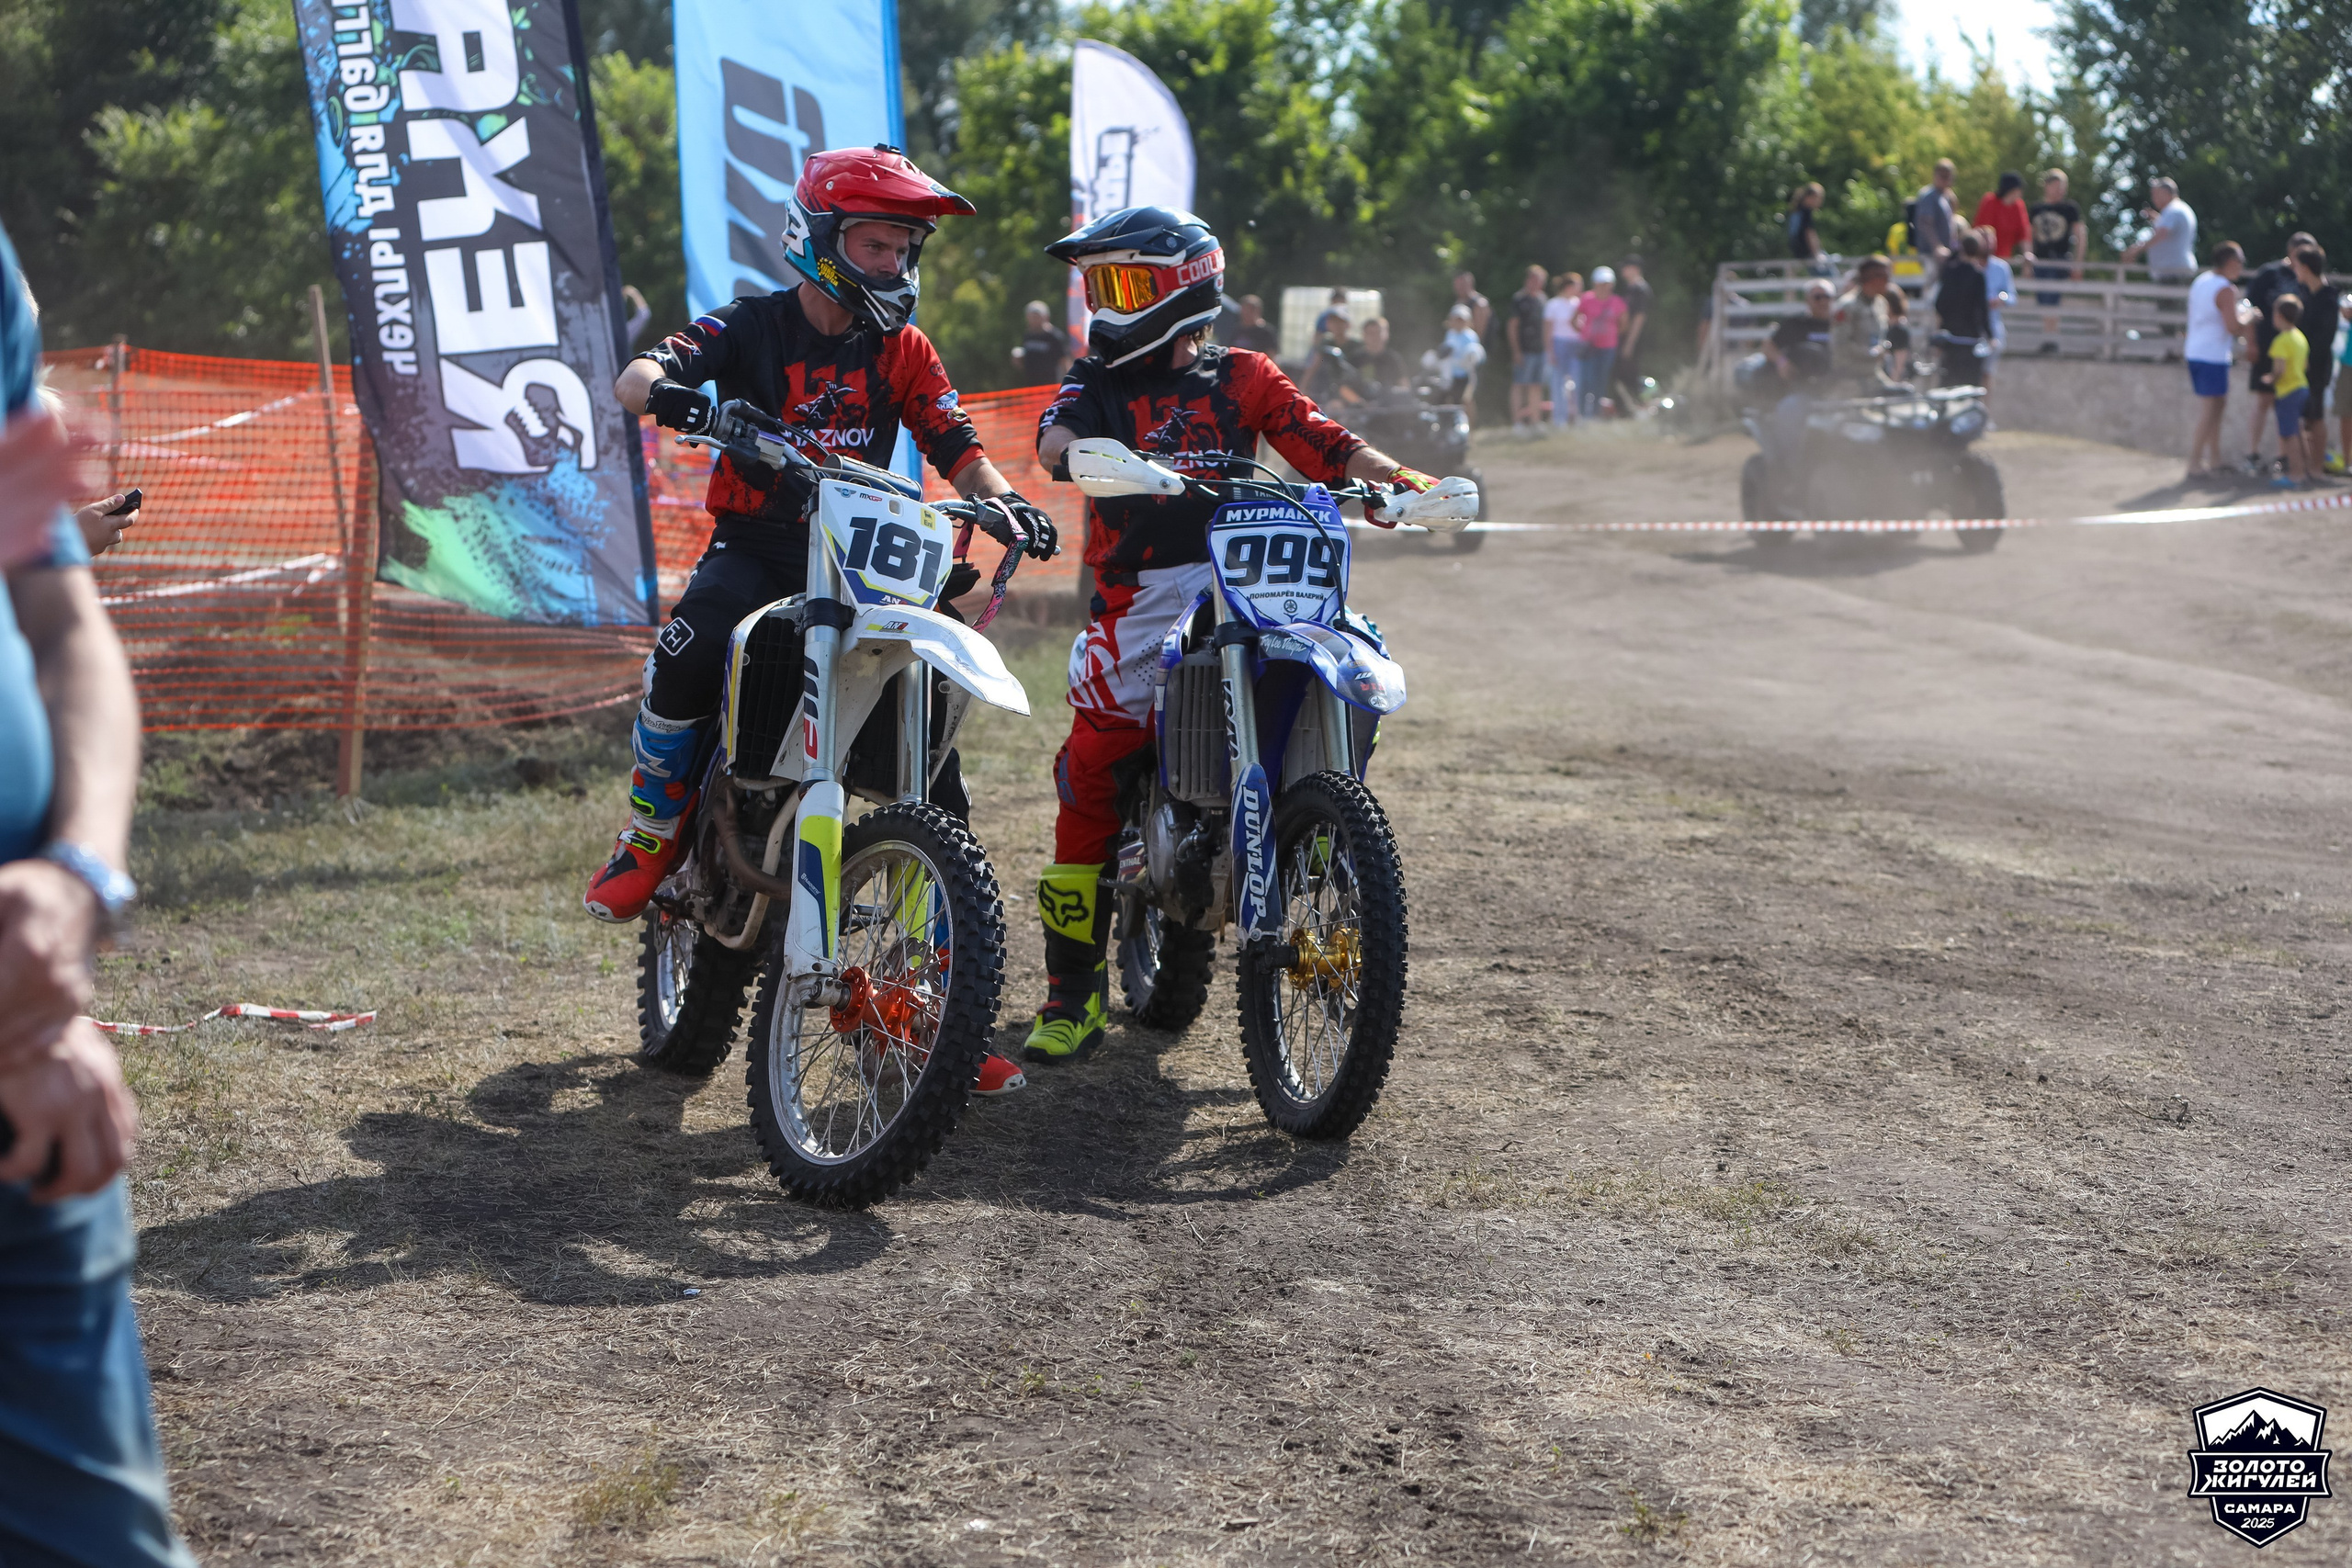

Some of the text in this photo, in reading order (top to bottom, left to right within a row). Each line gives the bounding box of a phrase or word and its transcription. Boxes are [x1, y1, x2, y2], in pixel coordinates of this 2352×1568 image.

[923, 519, 934, 529] Eni
[844, 516, 944, 596] 181
[1224, 534, 1345, 587] 999
[1250, 591, 1324, 601] ПОНОМАРЁВ ВАЛЕРИЙ
[1119, 857, 1141, 869] ENTHAL
[1242, 784, 1268, 918] DUNLOP
